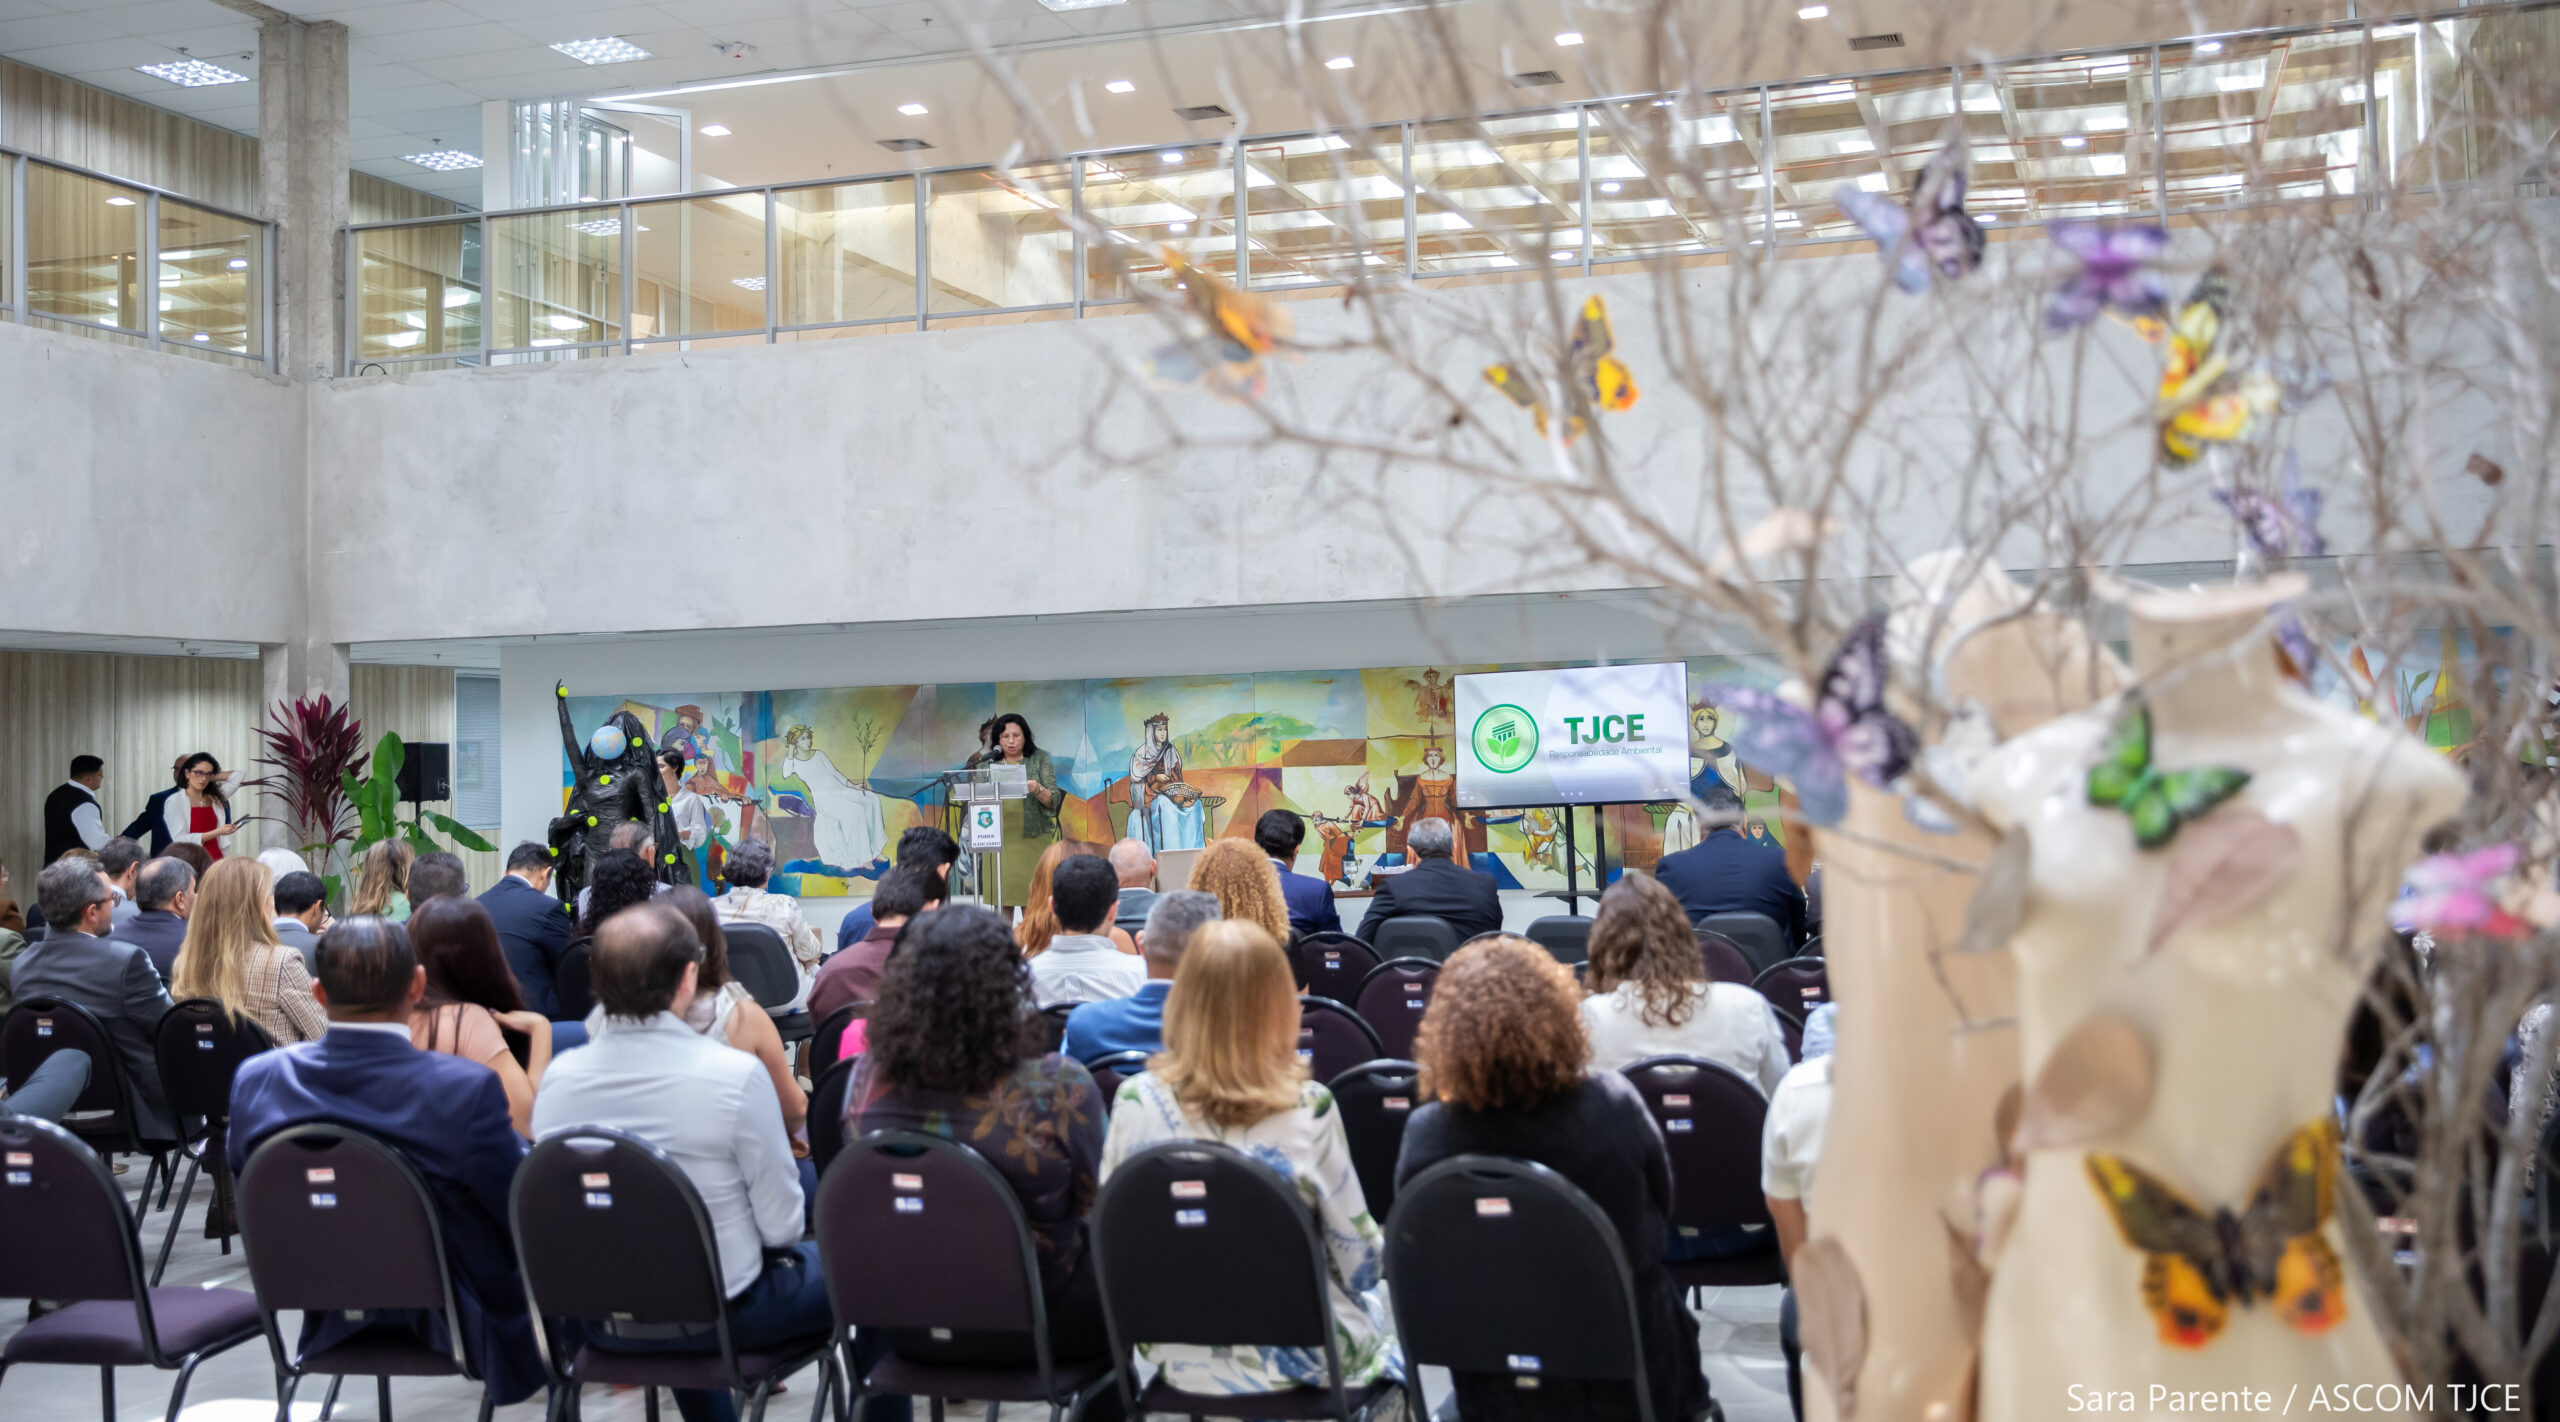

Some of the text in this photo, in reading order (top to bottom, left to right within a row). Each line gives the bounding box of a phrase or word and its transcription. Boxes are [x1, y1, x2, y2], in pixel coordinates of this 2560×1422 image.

[1563, 714, 1645, 744] TJCE
[1549, 745, 1662, 759] Responsabilidade Ambiental
